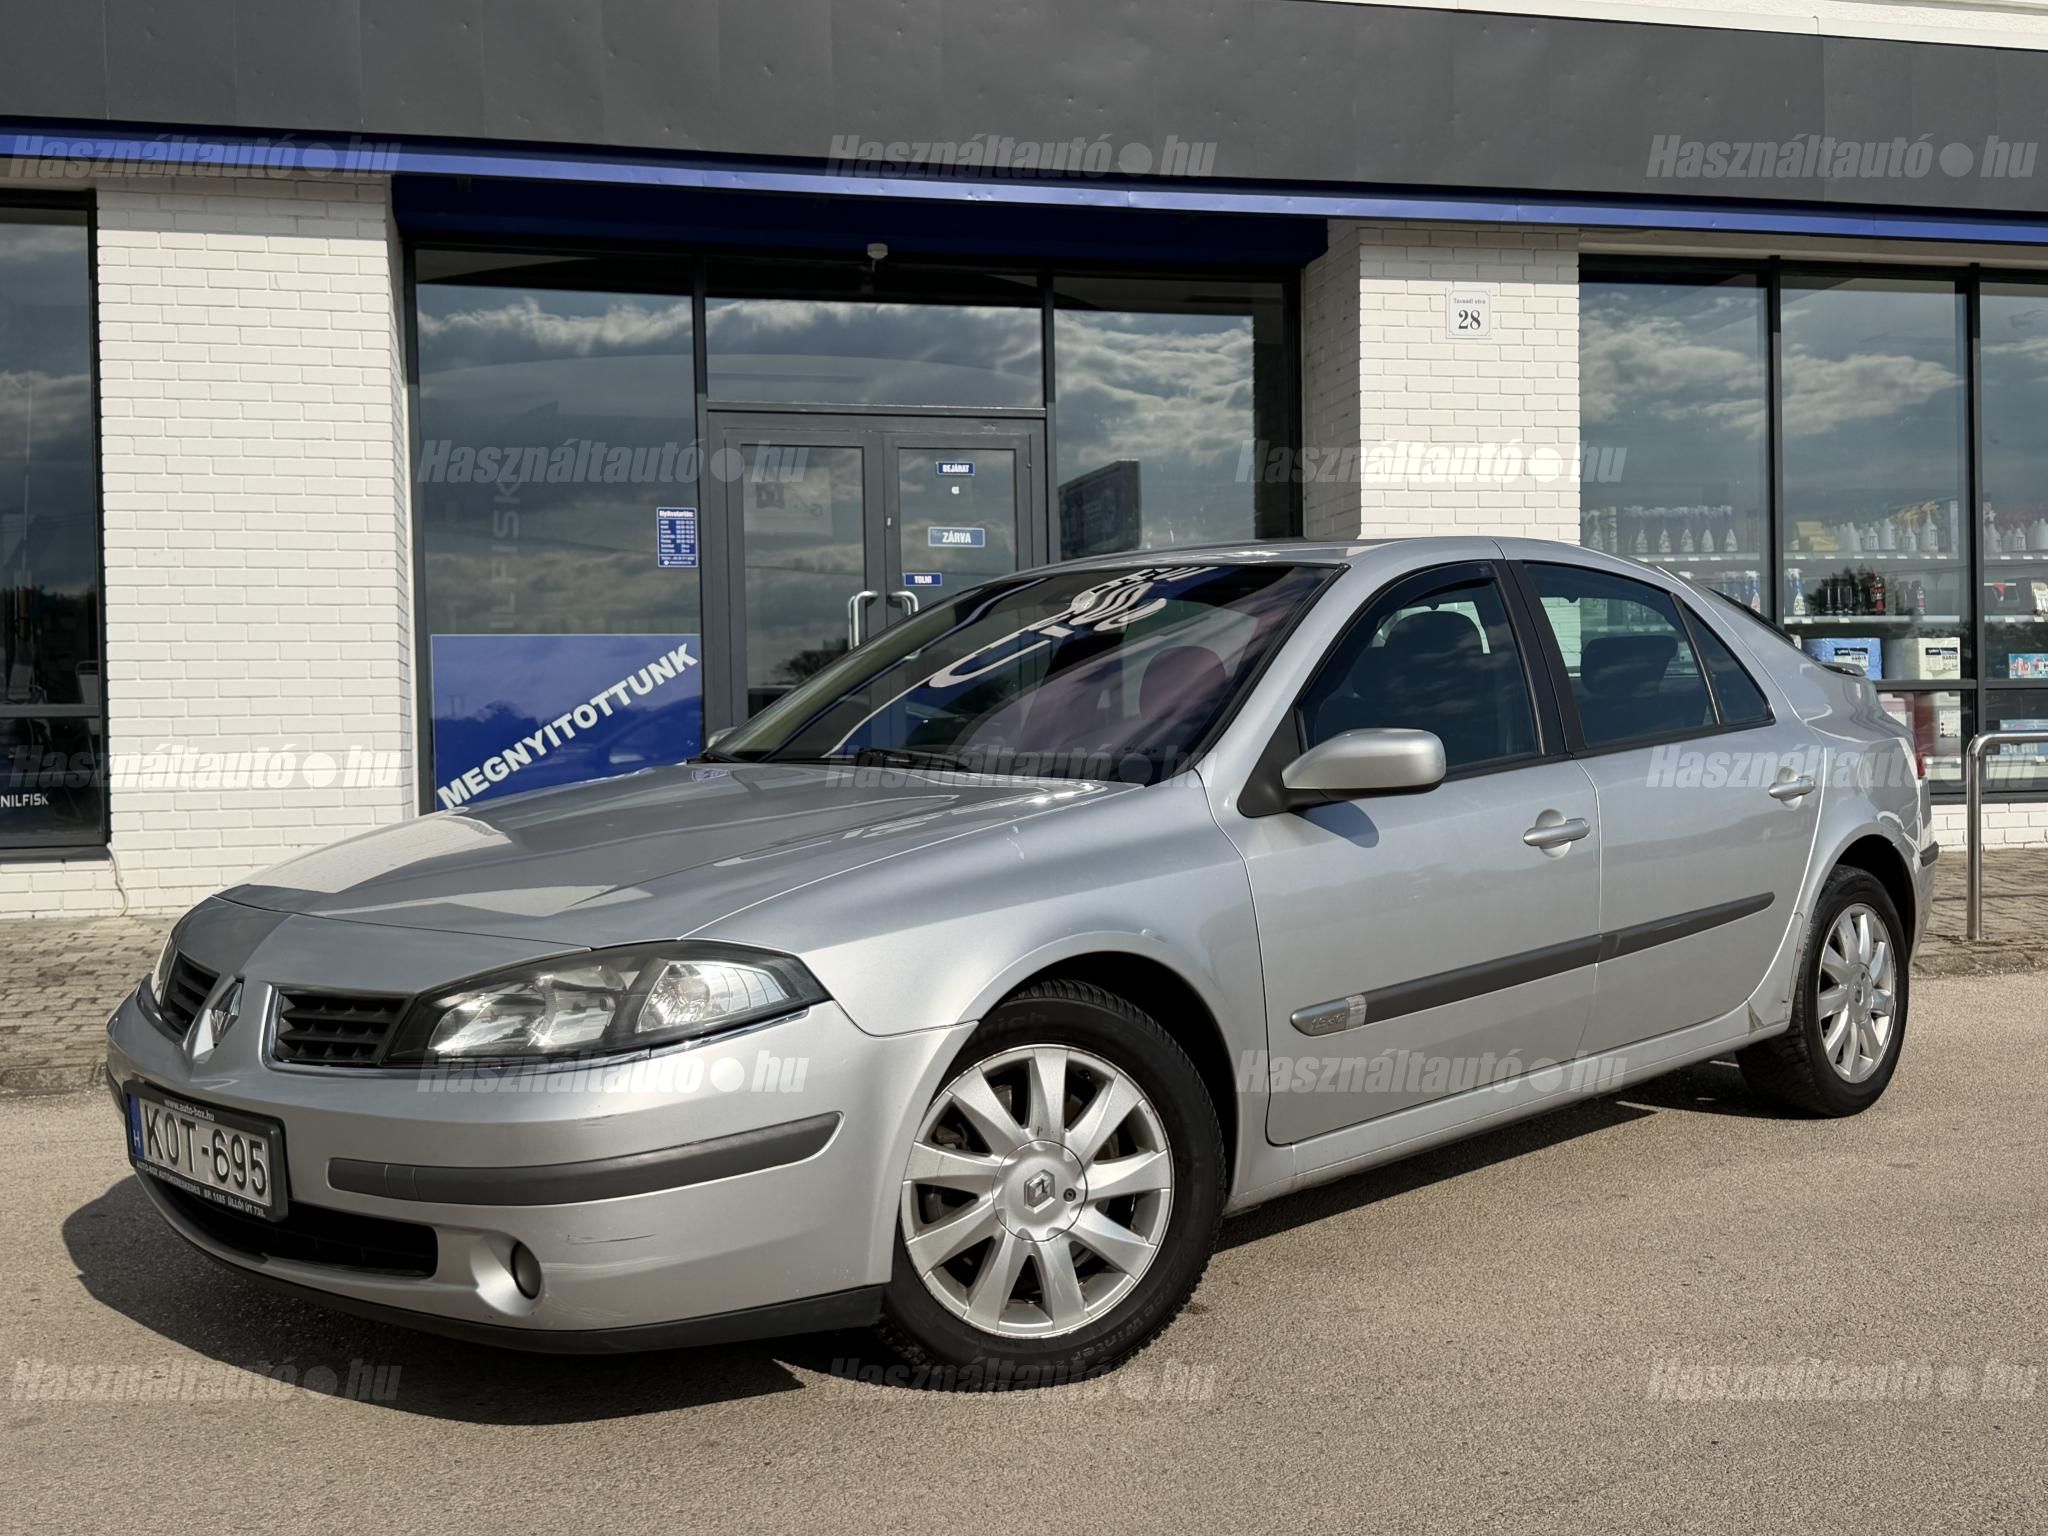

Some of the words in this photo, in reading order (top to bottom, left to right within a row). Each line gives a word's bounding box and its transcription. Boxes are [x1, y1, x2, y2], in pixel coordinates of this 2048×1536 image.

[1458, 309, 1481, 330] 28
[942, 464, 969, 473] BEJÁRAT
[942, 531, 971, 543] ZÁRVA
[489, 477, 520, 629] ILFISK
[437, 643, 699, 810] MEGNYITOTTUNK
[1, 793, 49, 808] NILFISK
[133, 1130, 141, 1148] H
[145, 1104, 267, 1197] KOT-695
